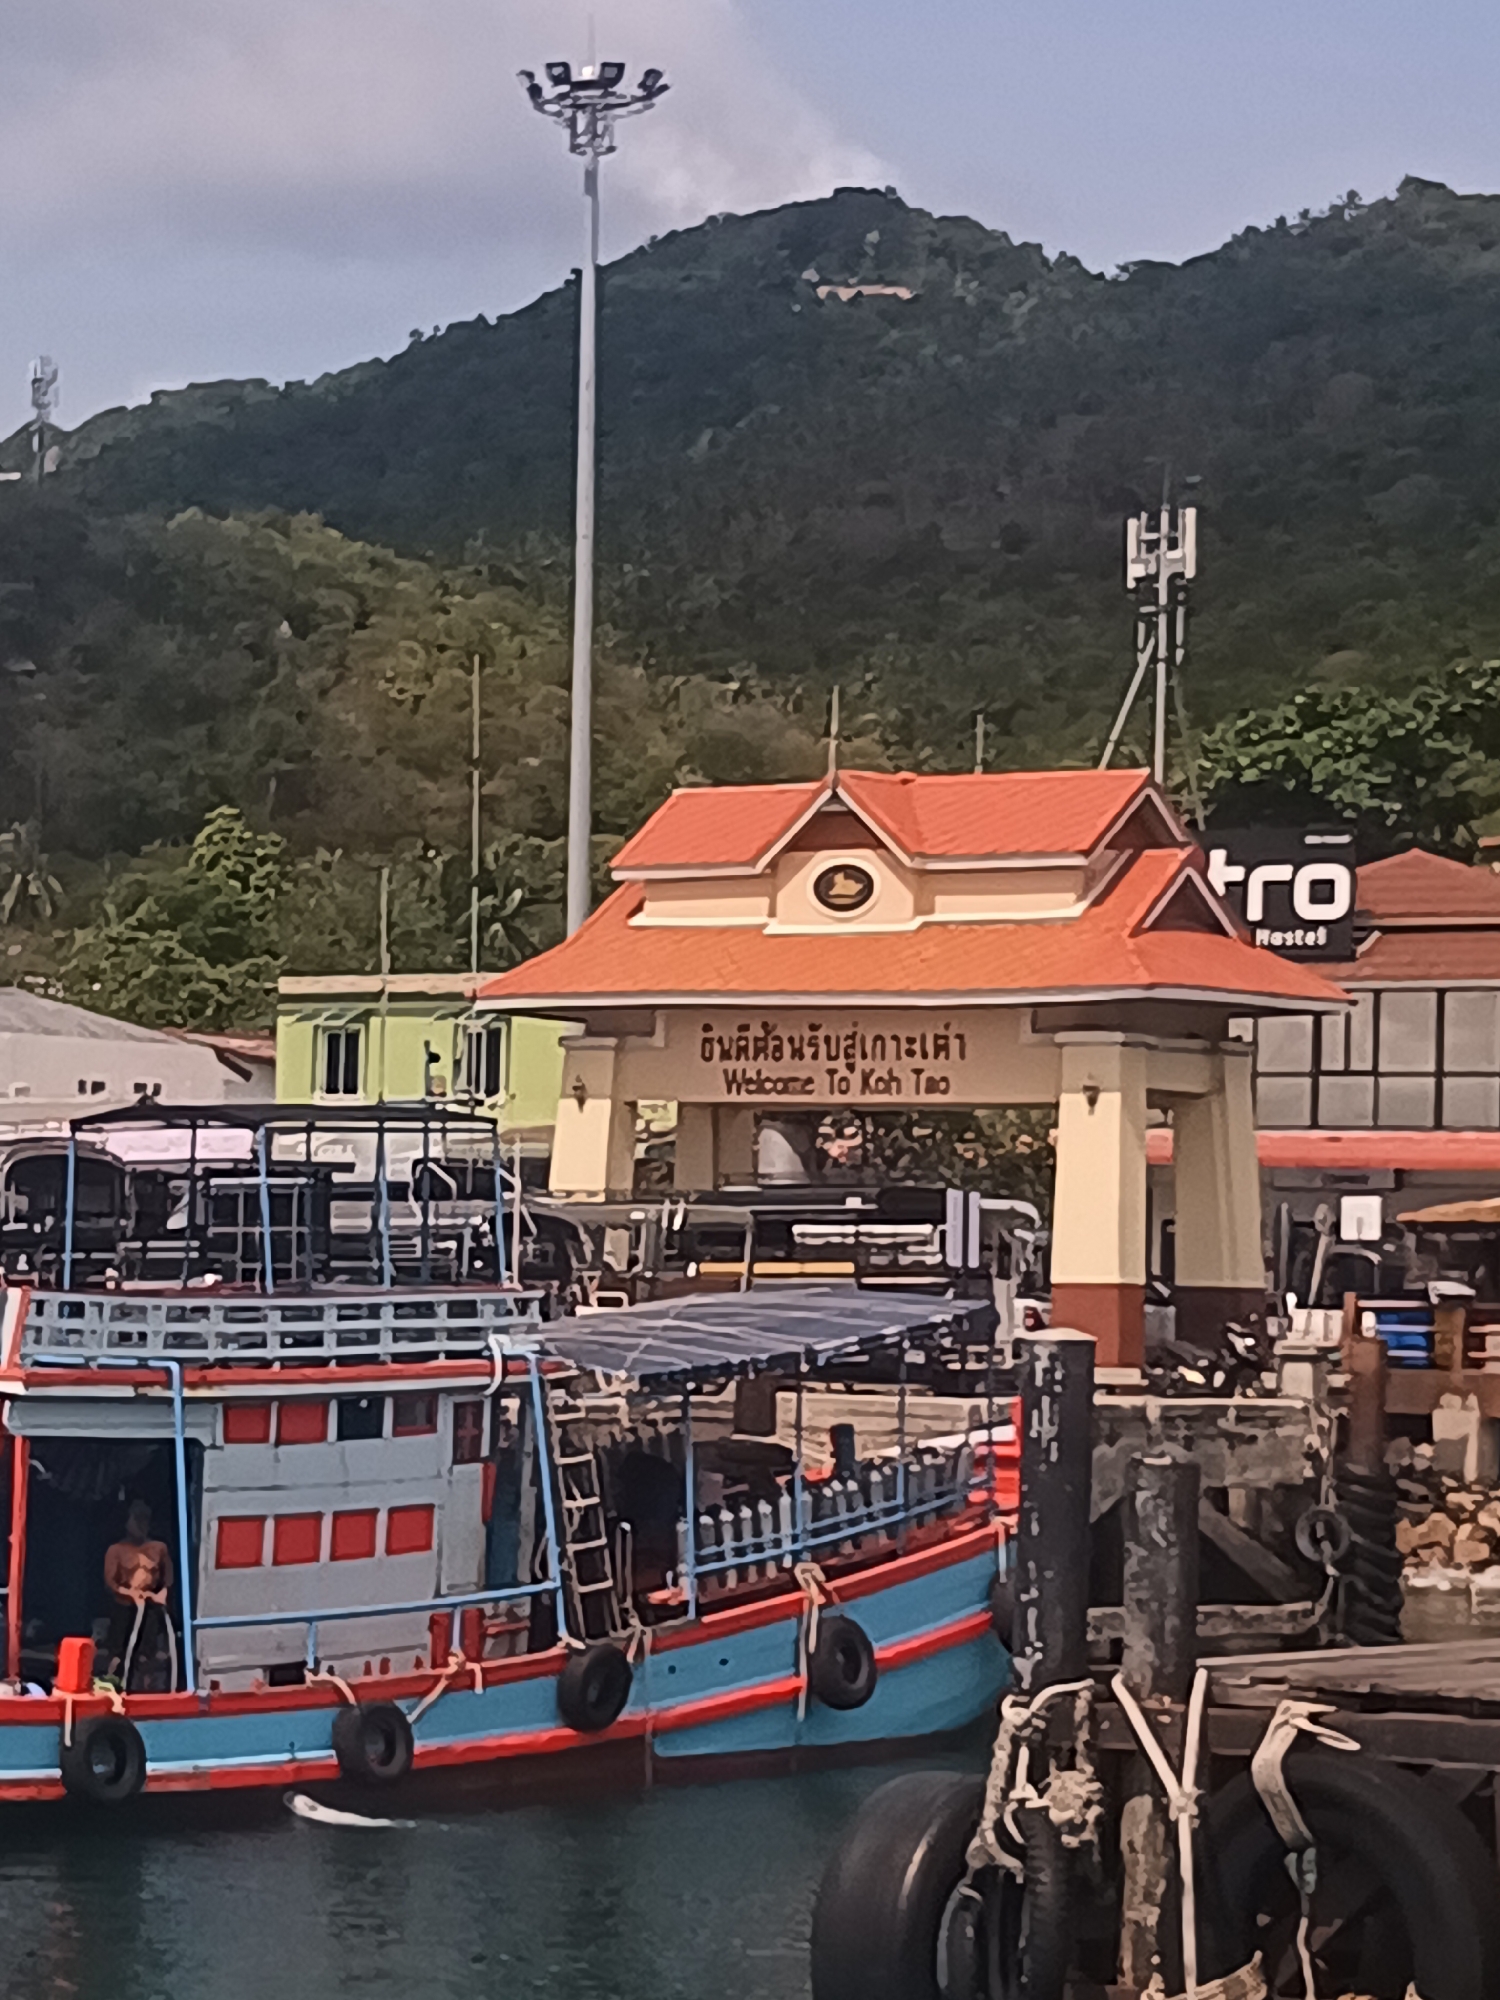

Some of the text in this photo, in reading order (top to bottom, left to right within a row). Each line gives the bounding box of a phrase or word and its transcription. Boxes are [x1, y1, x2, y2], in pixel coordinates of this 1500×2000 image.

[1255, 926, 1328, 946] Hostel
[722, 1066, 950, 1096] Welcome To Koh Tao
